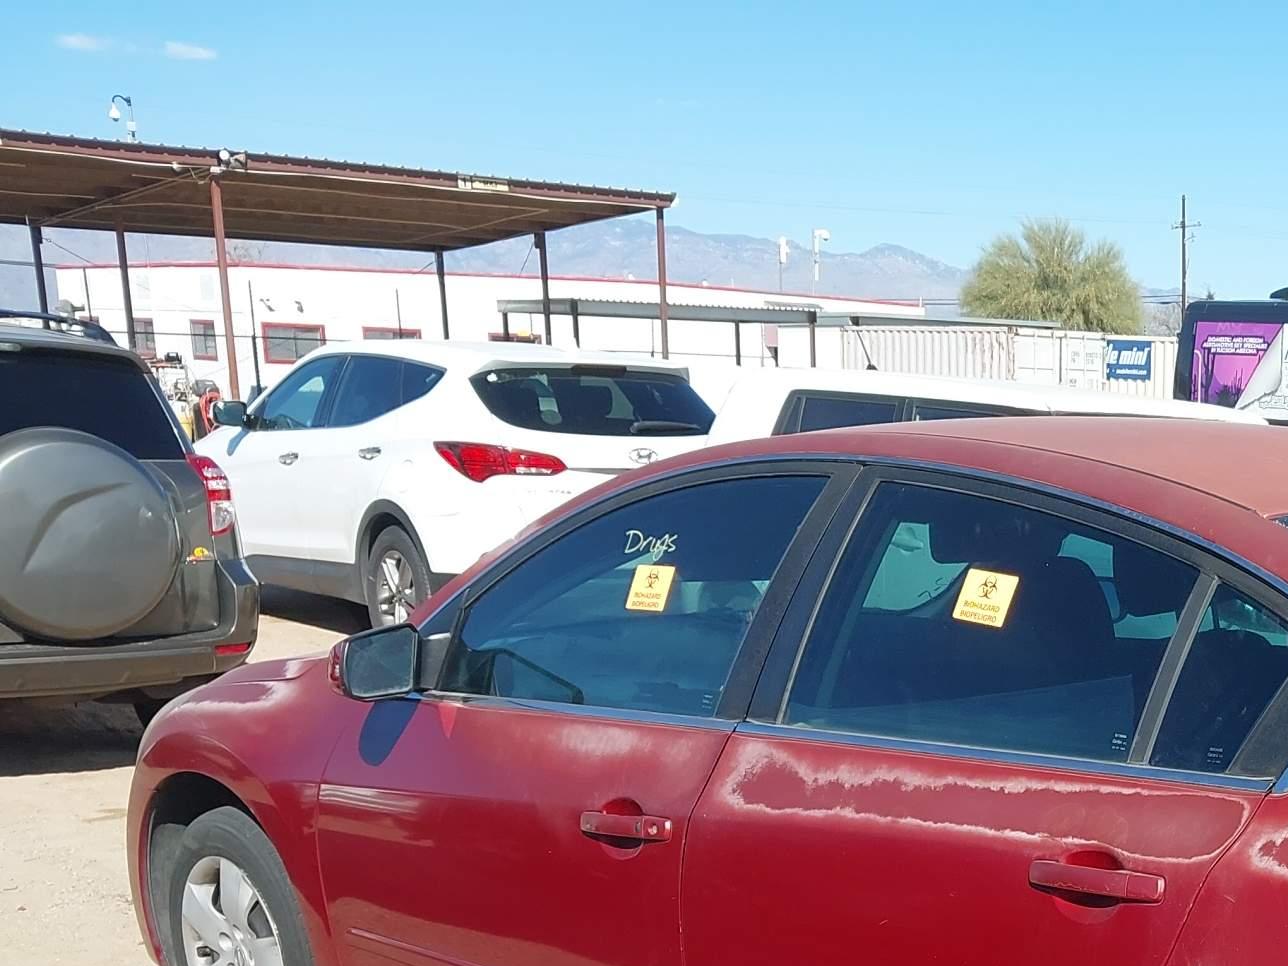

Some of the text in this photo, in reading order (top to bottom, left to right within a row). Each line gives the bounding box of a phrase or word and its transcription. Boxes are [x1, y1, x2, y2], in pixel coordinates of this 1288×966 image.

[624, 529, 678, 562] Drugs
[963, 600, 1001, 613] BIOHAZARD
[959, 609, 997, 623] BIOPELIGRO
